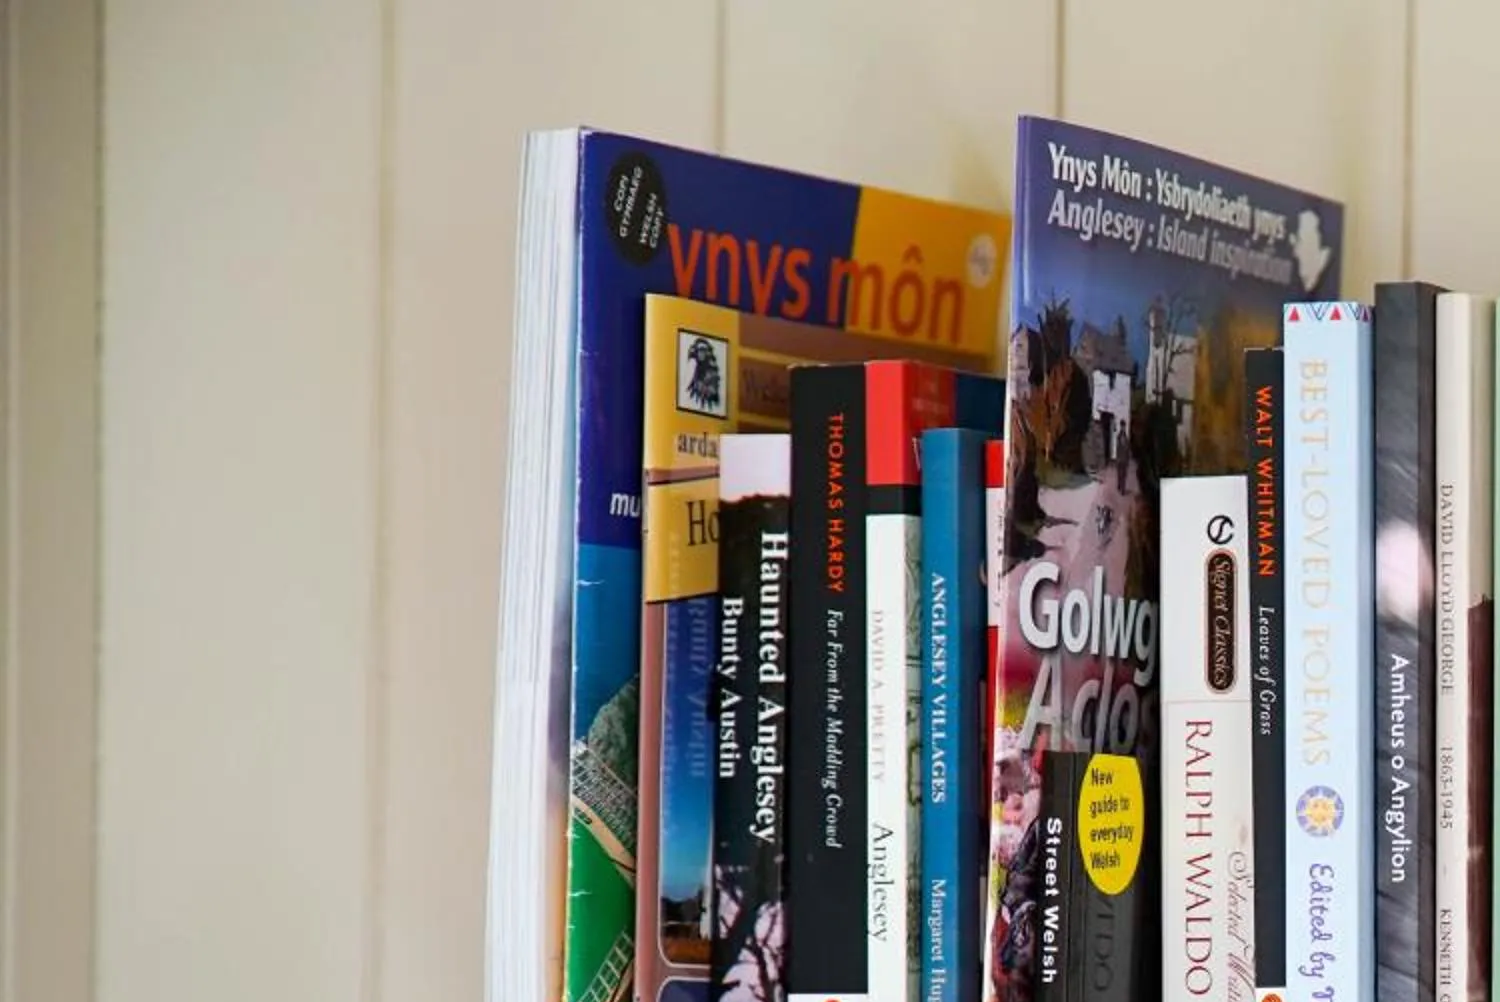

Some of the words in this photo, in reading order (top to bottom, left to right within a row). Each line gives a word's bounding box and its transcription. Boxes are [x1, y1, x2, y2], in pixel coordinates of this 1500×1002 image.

[1047, 141, 1097, 194] Ynys
[1102, 154, 1142, 200] Môn
[1047, 189, 1146, 254] Anglesey
[1156, 213, 1209, 262] Island
[826, 243, 966, 345] môn
[1255, 385, 1274, 448] WALT
[827, 412, 845, 510] THOMAS
[1299, 358, 1331, 609] BEST-LOVED
[1256, 458, 1276, 576] WHITMAN
[1439, 484, 1456, 545] DAVID
[827, 518, 845, 593] HARDY
[1210, 557, 1233, 612] Signet
[1439, 549, 1456, 614] LLOYD
[715, 597, 745, 681] Bunty
[758, 531, 789, 684] Haunted
[827, 609, 845, 636] Far
[871, 610, 885, 671] DAVID
[930, 572, 948, 688] ANGLESEY
[1019, 560, 1159, 687] Golwg
[1258, 604, 1277, 661] Leaves
[827, 640, 845, 684] From
[1214, 613, 1232, 687] Classics
[1253, 665, 1277, 688] of
[1439, 616, 1456, 697] GEORGE
[718, 687, 743, 779] Austin
[826, 685, 844, 714] the
[1258, 687, 1277, 737] Grass
[1301, 627, 1331, 767] POEMS
[1390, 653, 1412, 748] Amheus
[749, 696, 785, 845] Anglesey
[821, 716, 845, 791] Madding
[871, 704, 886, 783] PRETTY
[930, 694, 948, 804] VILLAGES
[1091, 767, 1113, 786] New
[1185, 719, 1213, 838] RALPH
[1390, 753, 1405, 771] o
[825, 792, 844, 850] Crowd
[1089, 793, 1118, 818] guide
[1439, 745, 1456, 831] 1863-1945
[1045, 816, 1063, 896] Street
[1089, 822, 1135, 844] everyday
[1090, 850, 1121, 870] Welsh
[1385, 775, 1413, 882] Angylion
[869, 822, 895, 943] Anglesey
[927, 879, 948, 962] Margaret
[1227, 850, 1255, 944] Selected
[1307, 862, 1336, 943] Edited
[1041, 905, 1060, 984] Welsh
[1185, 852, 1213, 997] WALDO
[1437, 908, 1452, 987] KENNETH
[1298, 950, 1336, 980] by
